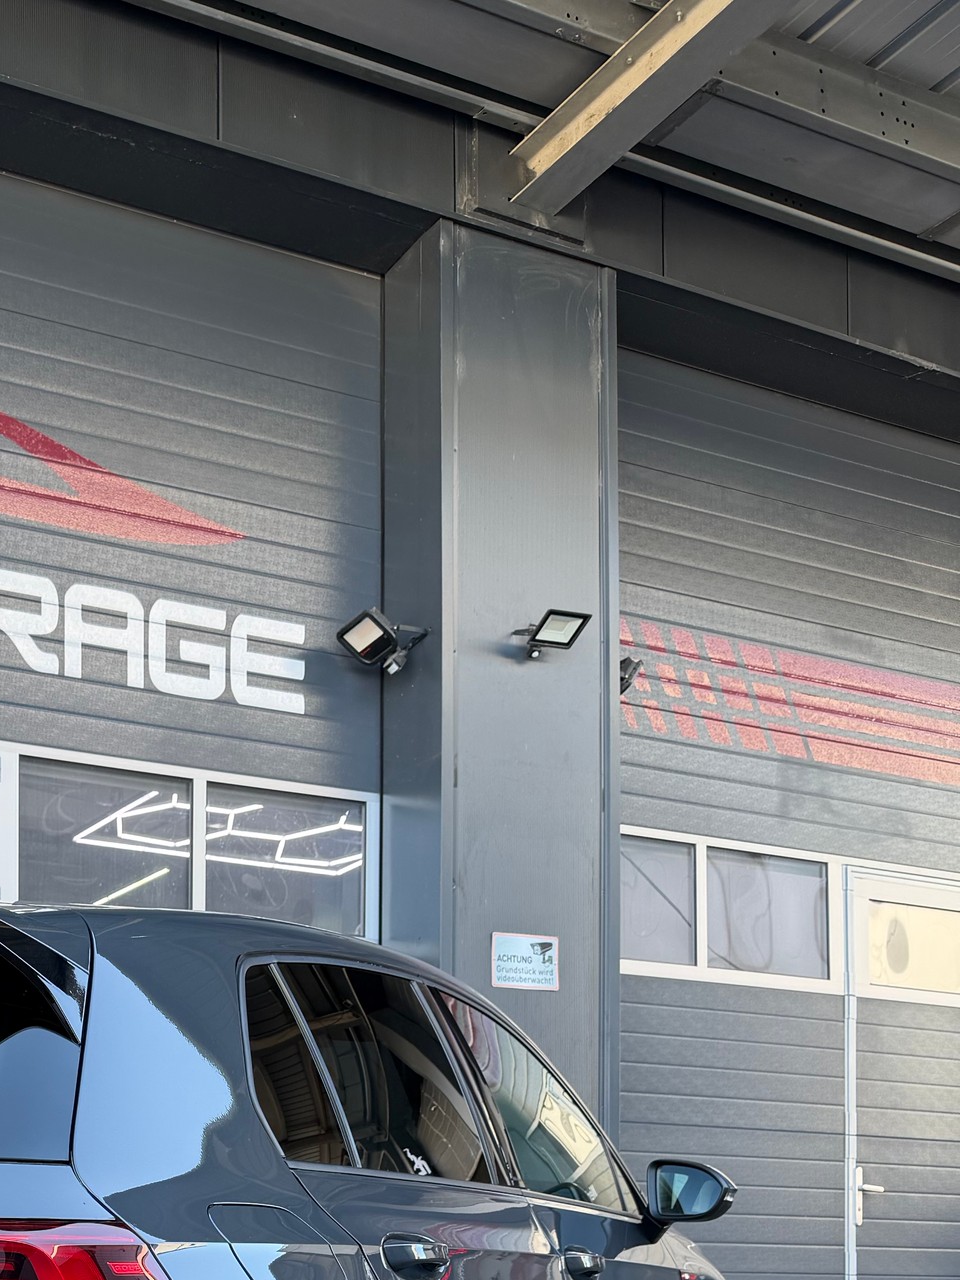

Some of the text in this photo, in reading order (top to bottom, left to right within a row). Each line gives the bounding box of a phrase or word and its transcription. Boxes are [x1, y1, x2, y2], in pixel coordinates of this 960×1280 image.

[496, 954, 533, 964] ACHTUNG
[496, 965, 554, 977] Grundstück wird
[496, 974, 554, 985] videoüberwacht!
